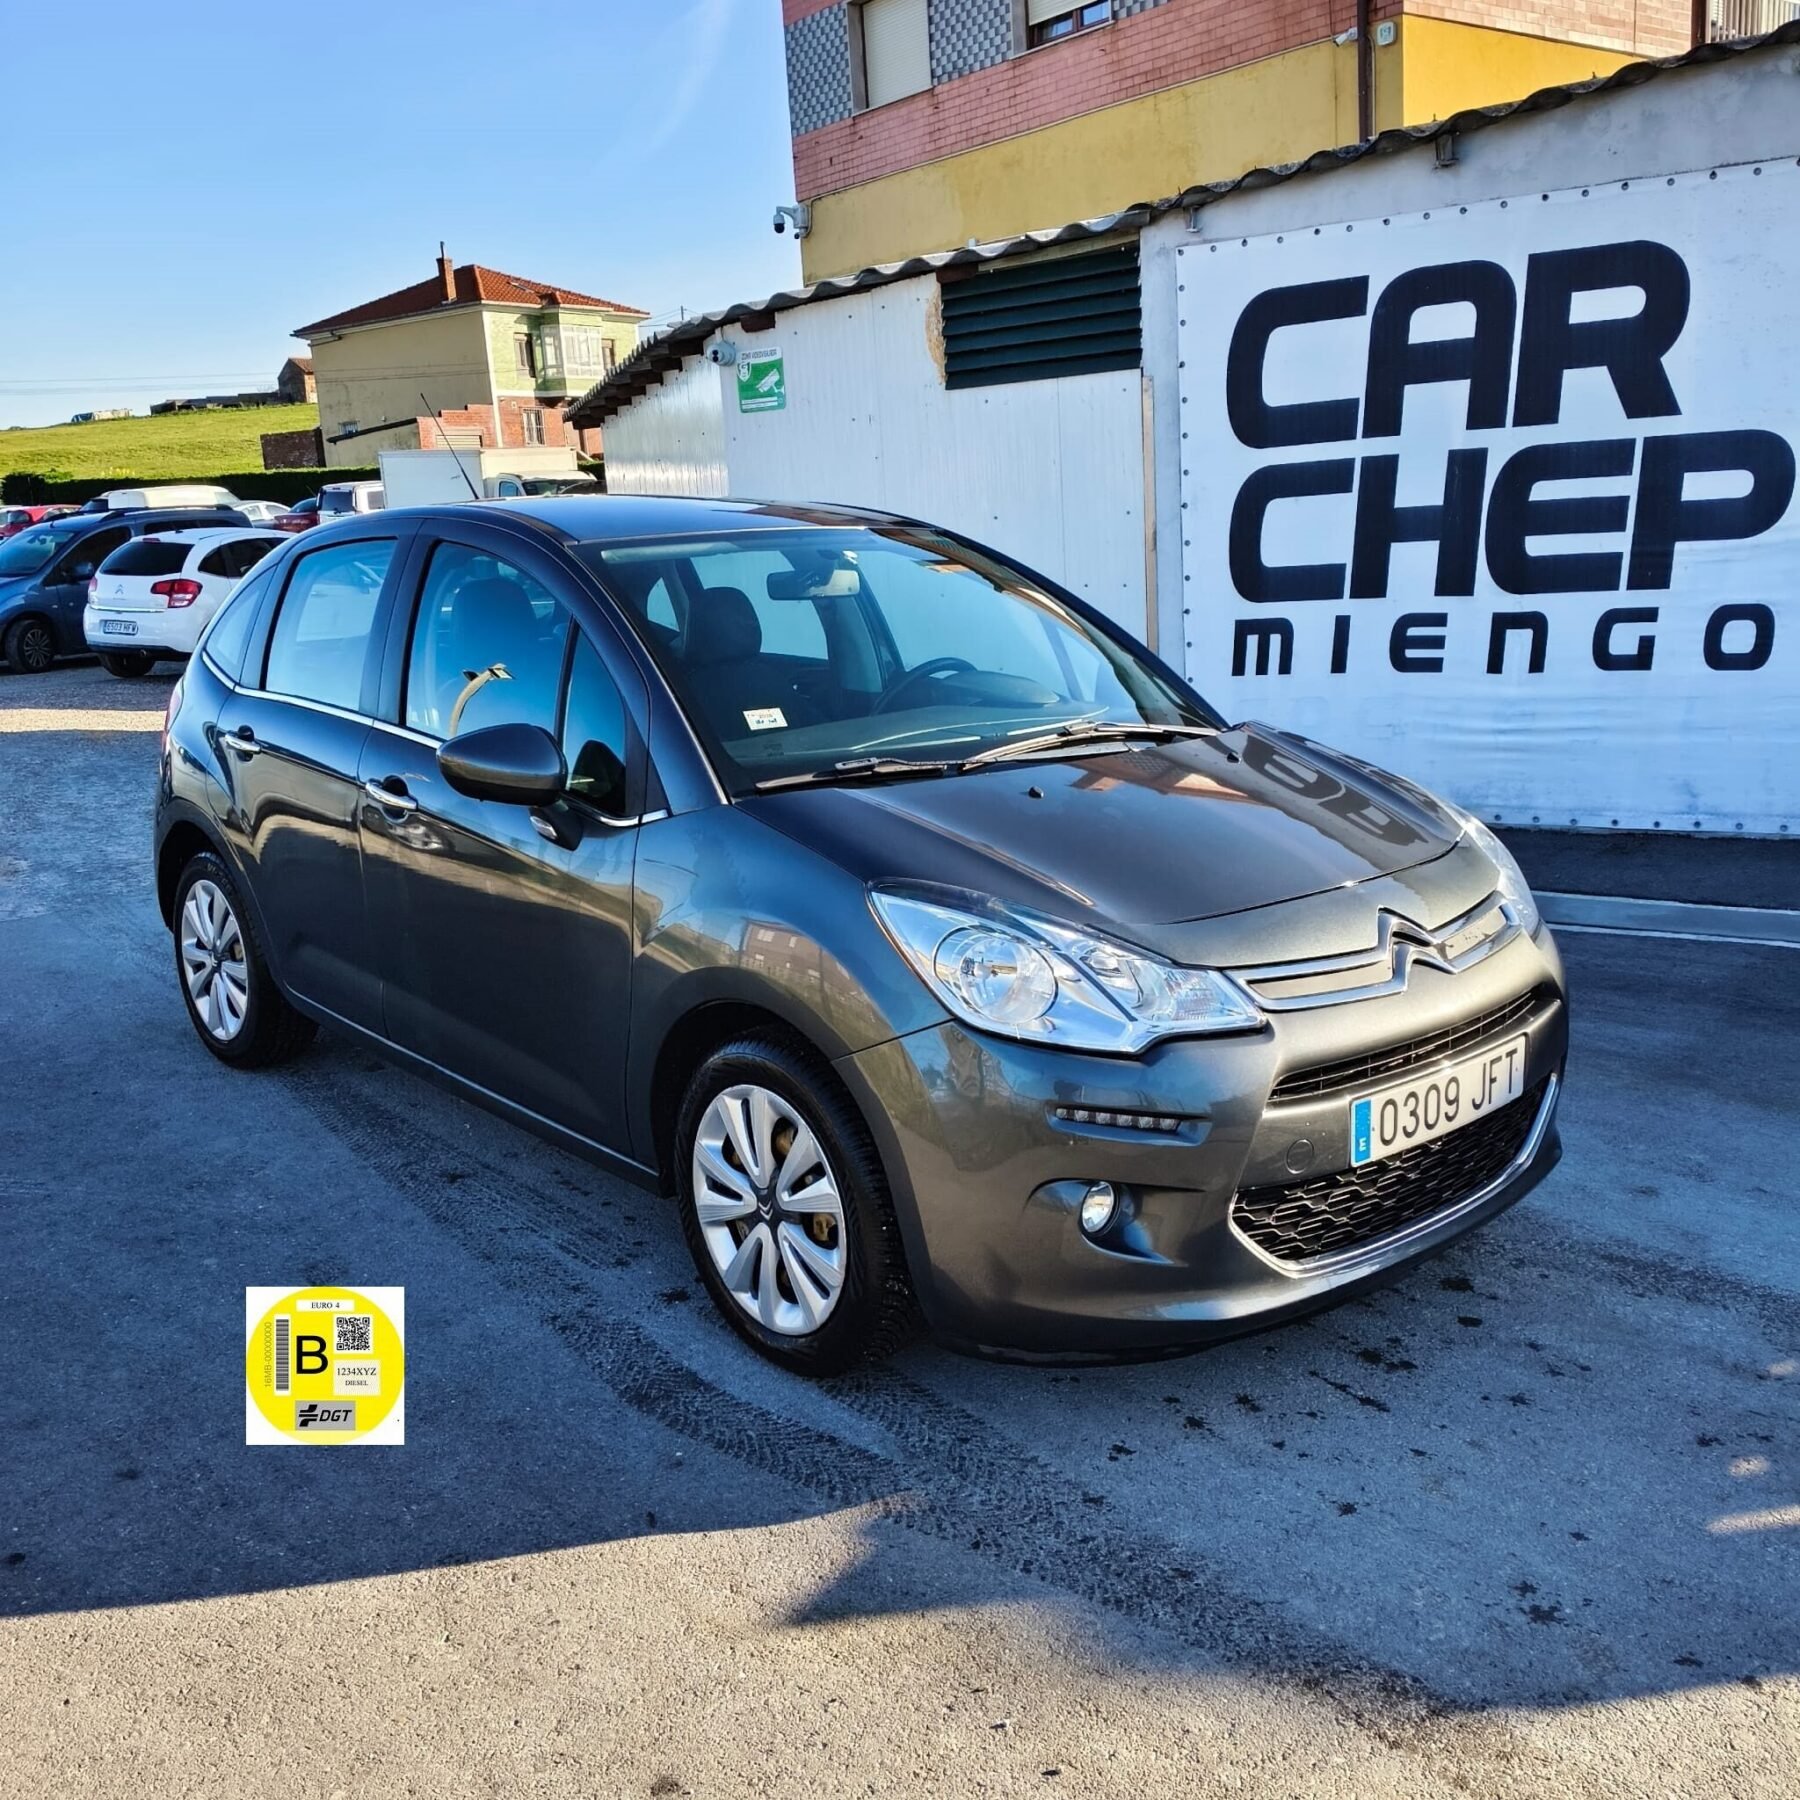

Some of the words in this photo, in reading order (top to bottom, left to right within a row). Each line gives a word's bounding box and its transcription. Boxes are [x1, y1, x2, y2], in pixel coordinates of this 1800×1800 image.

[1226, 240, 1690, 449] CAR
[1229, 429, 1796, 603] CHEP
[1231, 603, 1775, 676] MIENGO
[1379, 1076, 1460, 1146] 0309
[1471, 1047, 1518, 1111] JFT
